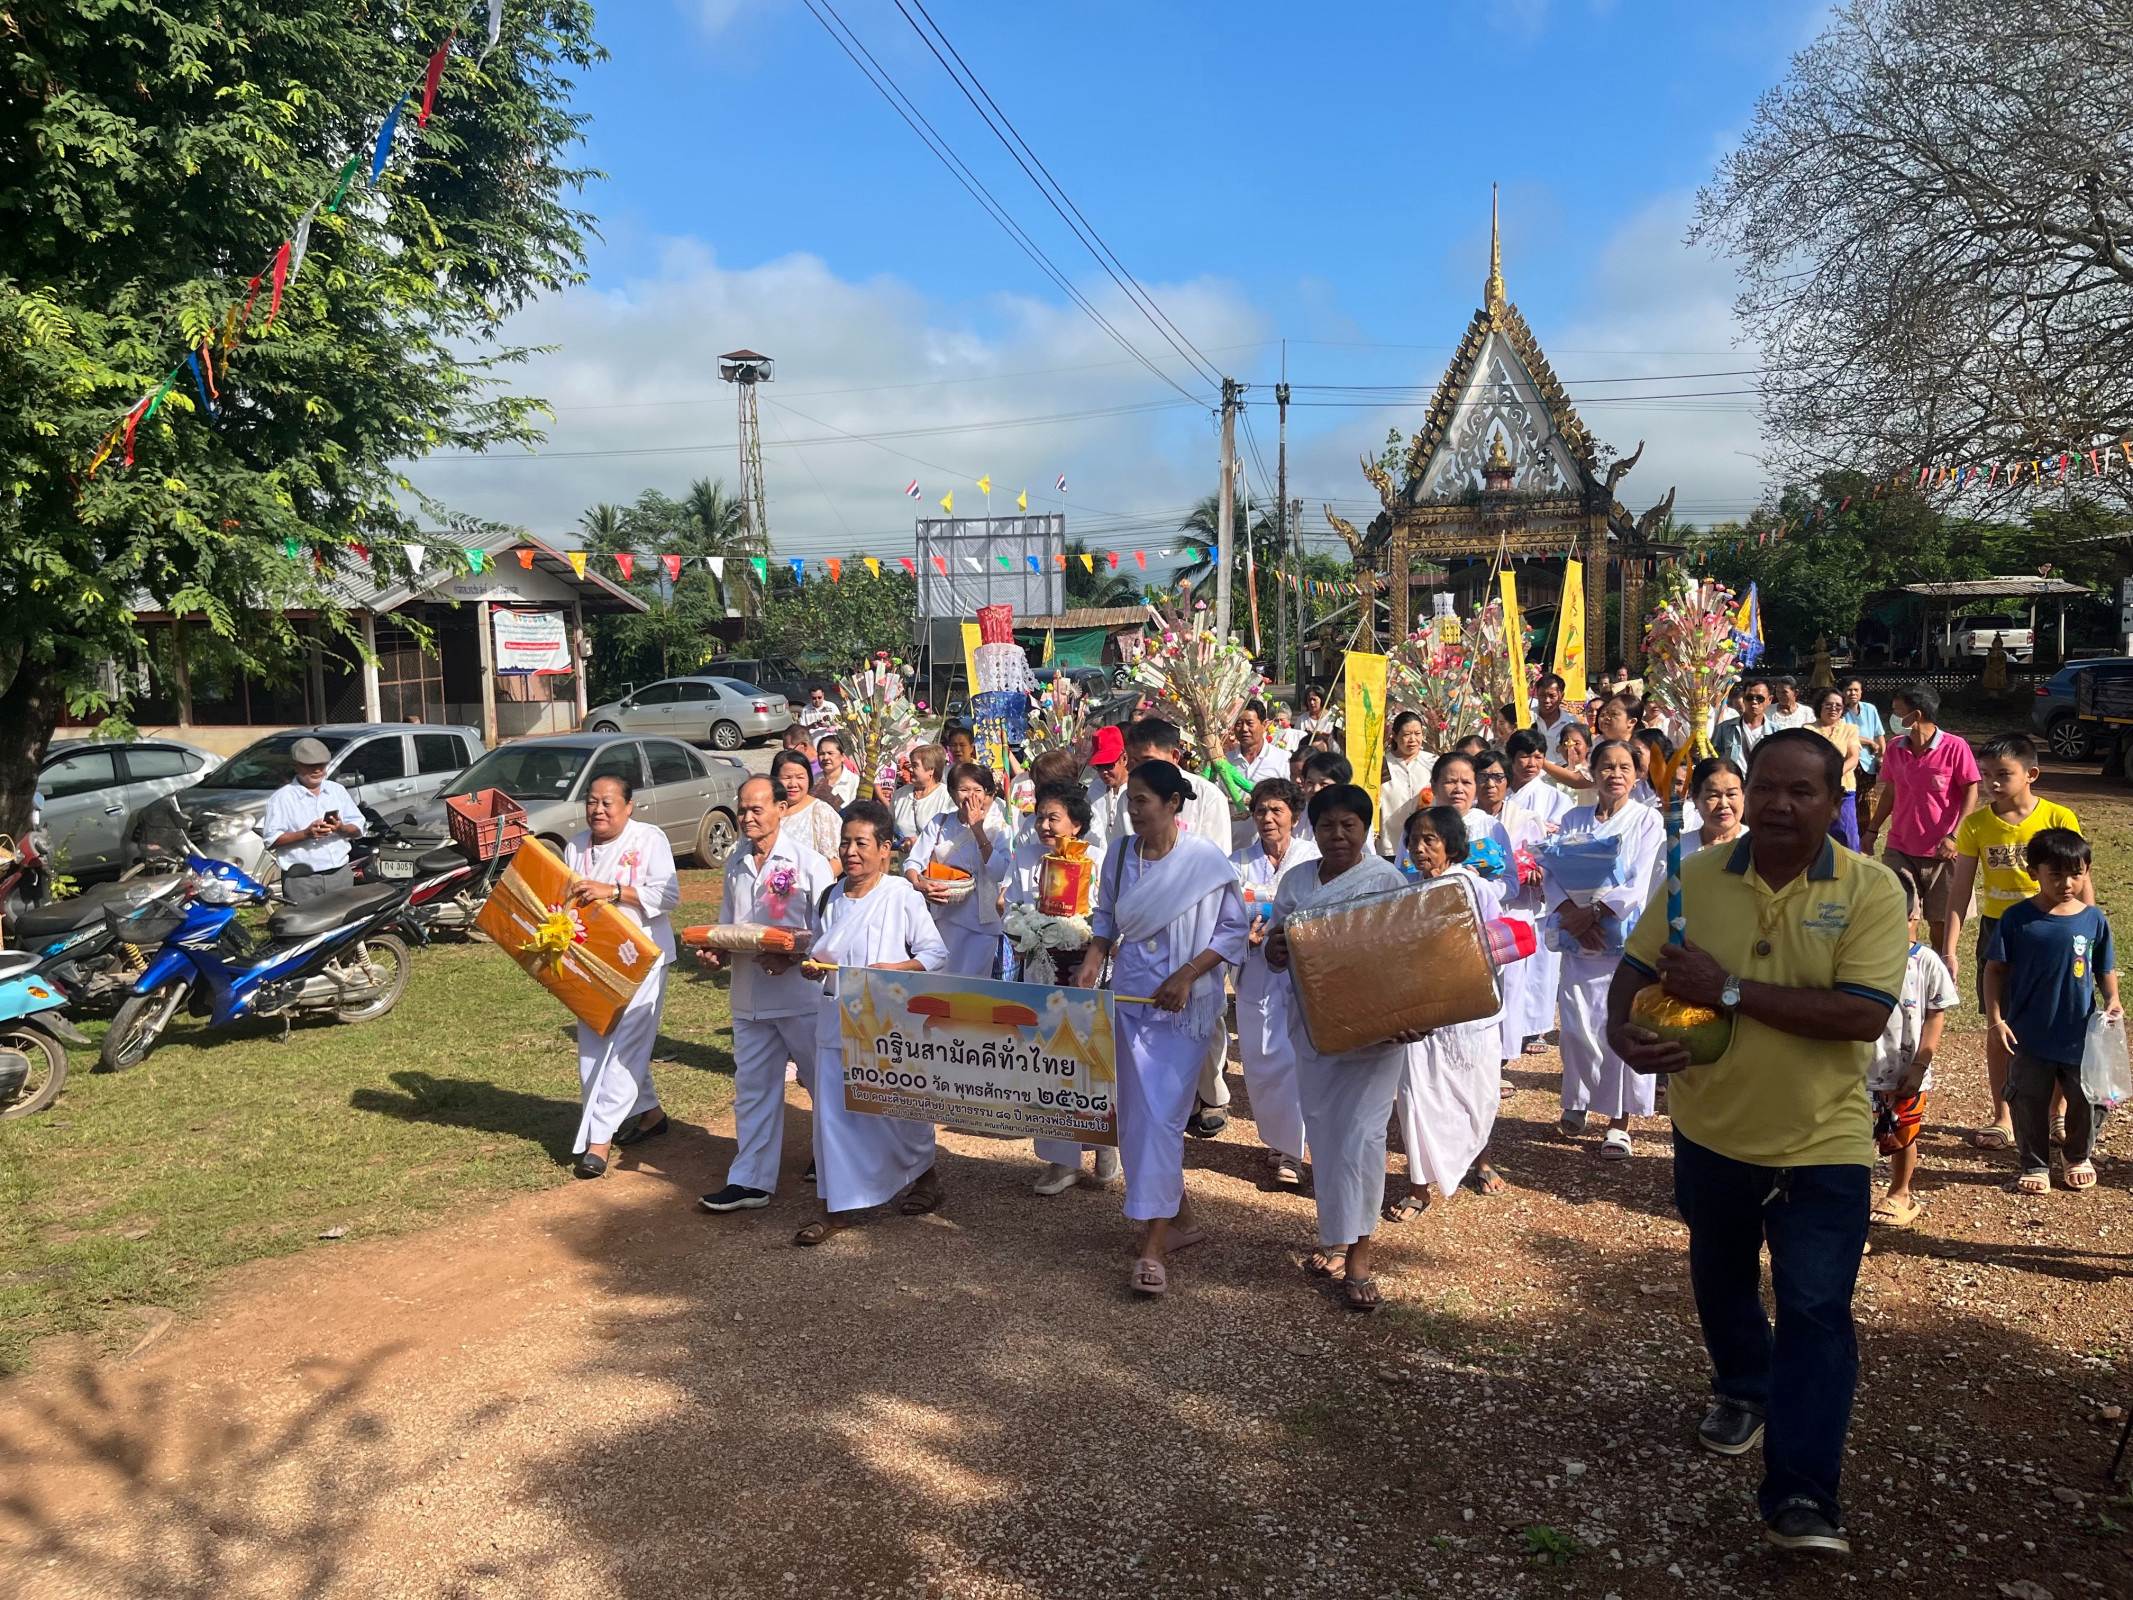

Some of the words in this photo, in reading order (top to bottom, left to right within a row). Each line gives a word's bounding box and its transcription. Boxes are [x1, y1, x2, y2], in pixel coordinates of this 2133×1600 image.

[397, 862, 412, 871] 3057
[875, 1031, 1075, 1077] กฐินสามัคคีทั่วไทย
[851, 1066, 927, 1089] ๓๐,๐๐๐
[932, 1074, 950, 1092] วัด
[954, 1081, 1031, 1102] พุทธศักราช
[1037, 1087, 1108, 1111] ๒๕๖๘
[851, 1086, 870, 1100] โดย
[872, 1093, 945, 1111] คณะศิษยานุศิษย์
[947, 1103, 993, 1117] บูชาธรรม
[996, 1110, 1011, 1120] ๘๑
[1013, 1108, 1022, 1121] ปี
[1025, 1113, 1108, 1131] หลวงพ่อธัมมชโย
